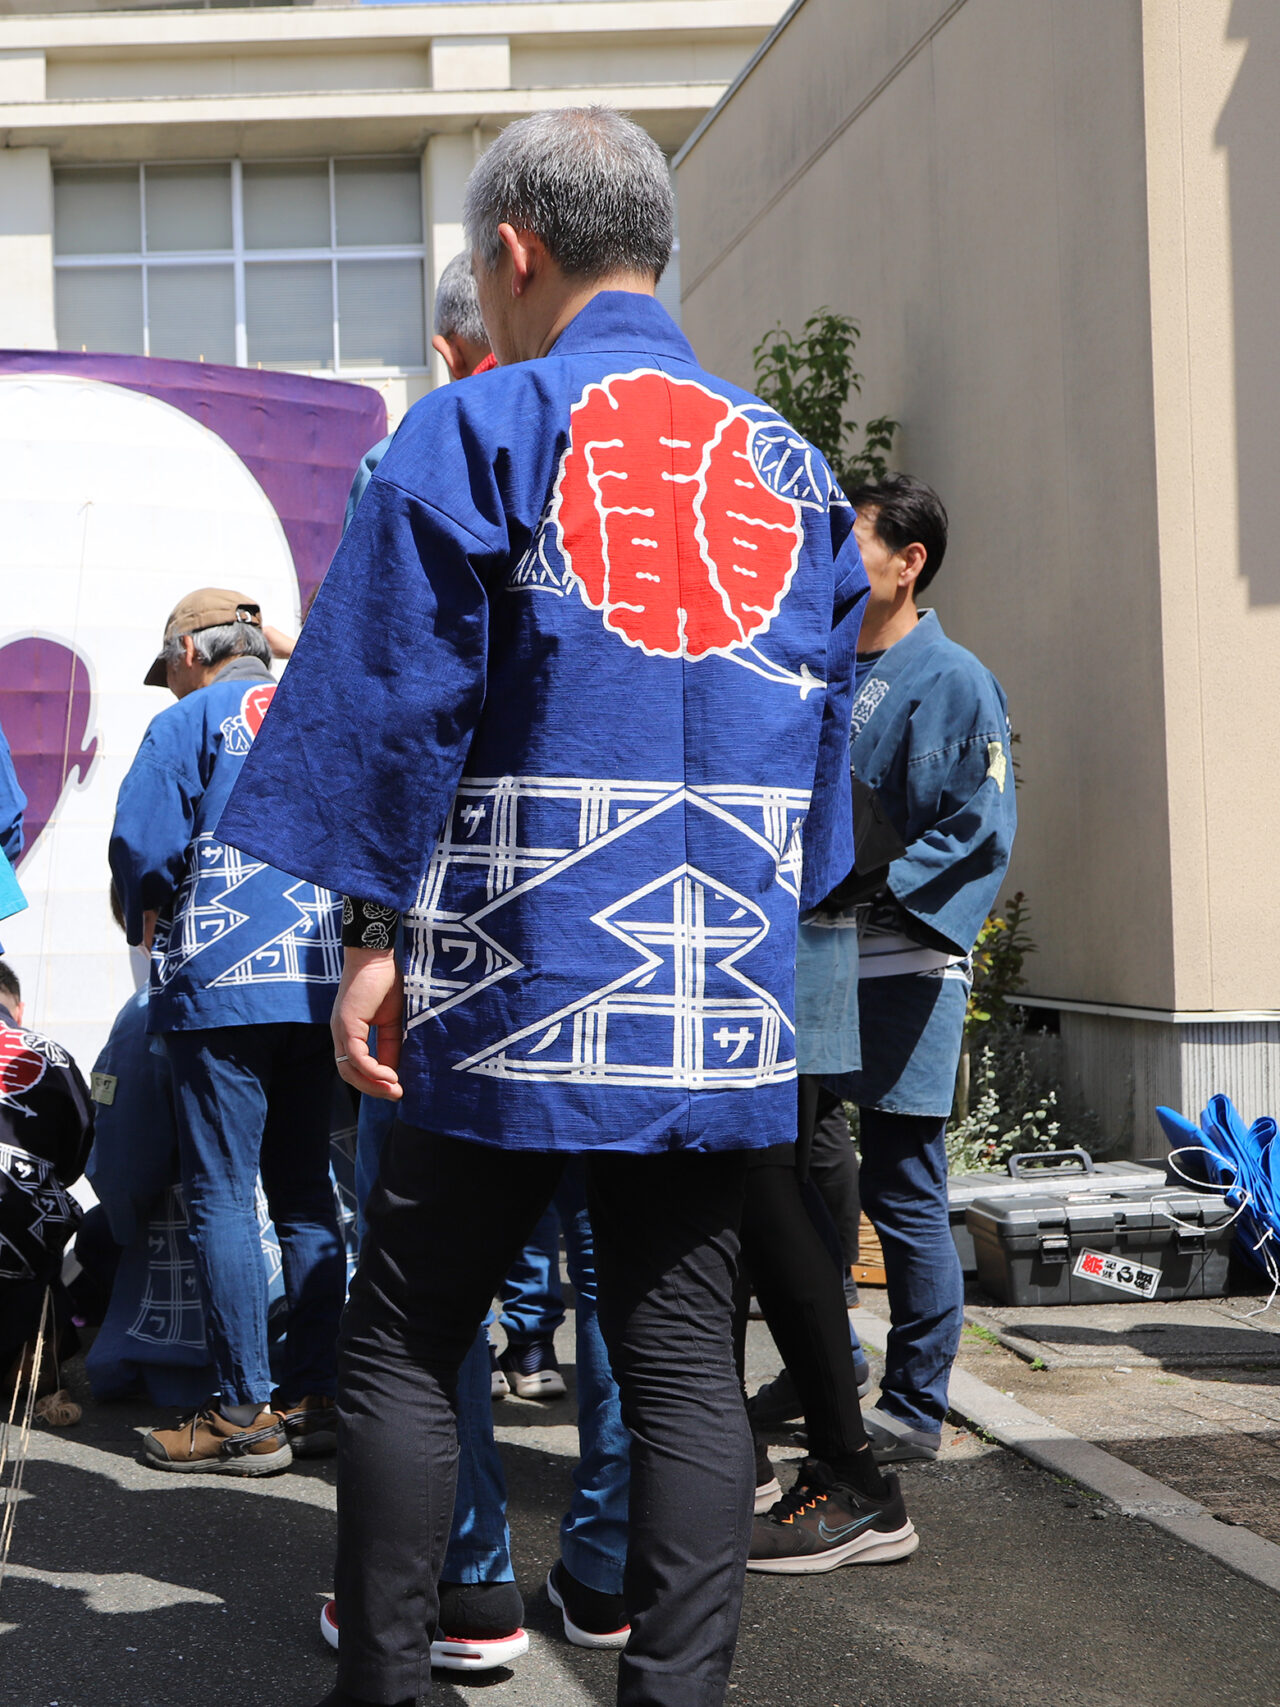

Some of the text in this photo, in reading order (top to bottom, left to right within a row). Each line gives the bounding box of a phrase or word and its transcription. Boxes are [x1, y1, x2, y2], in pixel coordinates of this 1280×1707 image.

[460, 804, 487, 839] サ
[201, 846, 223, 865] サ
[200, 919, 225, 936] ワ
[256, 951, 280, 968] ワ
[441, 939, 477, 973] ワ
[713, 1026, 755, 1063] サ
[15, 1161, 35, 1179] サ
